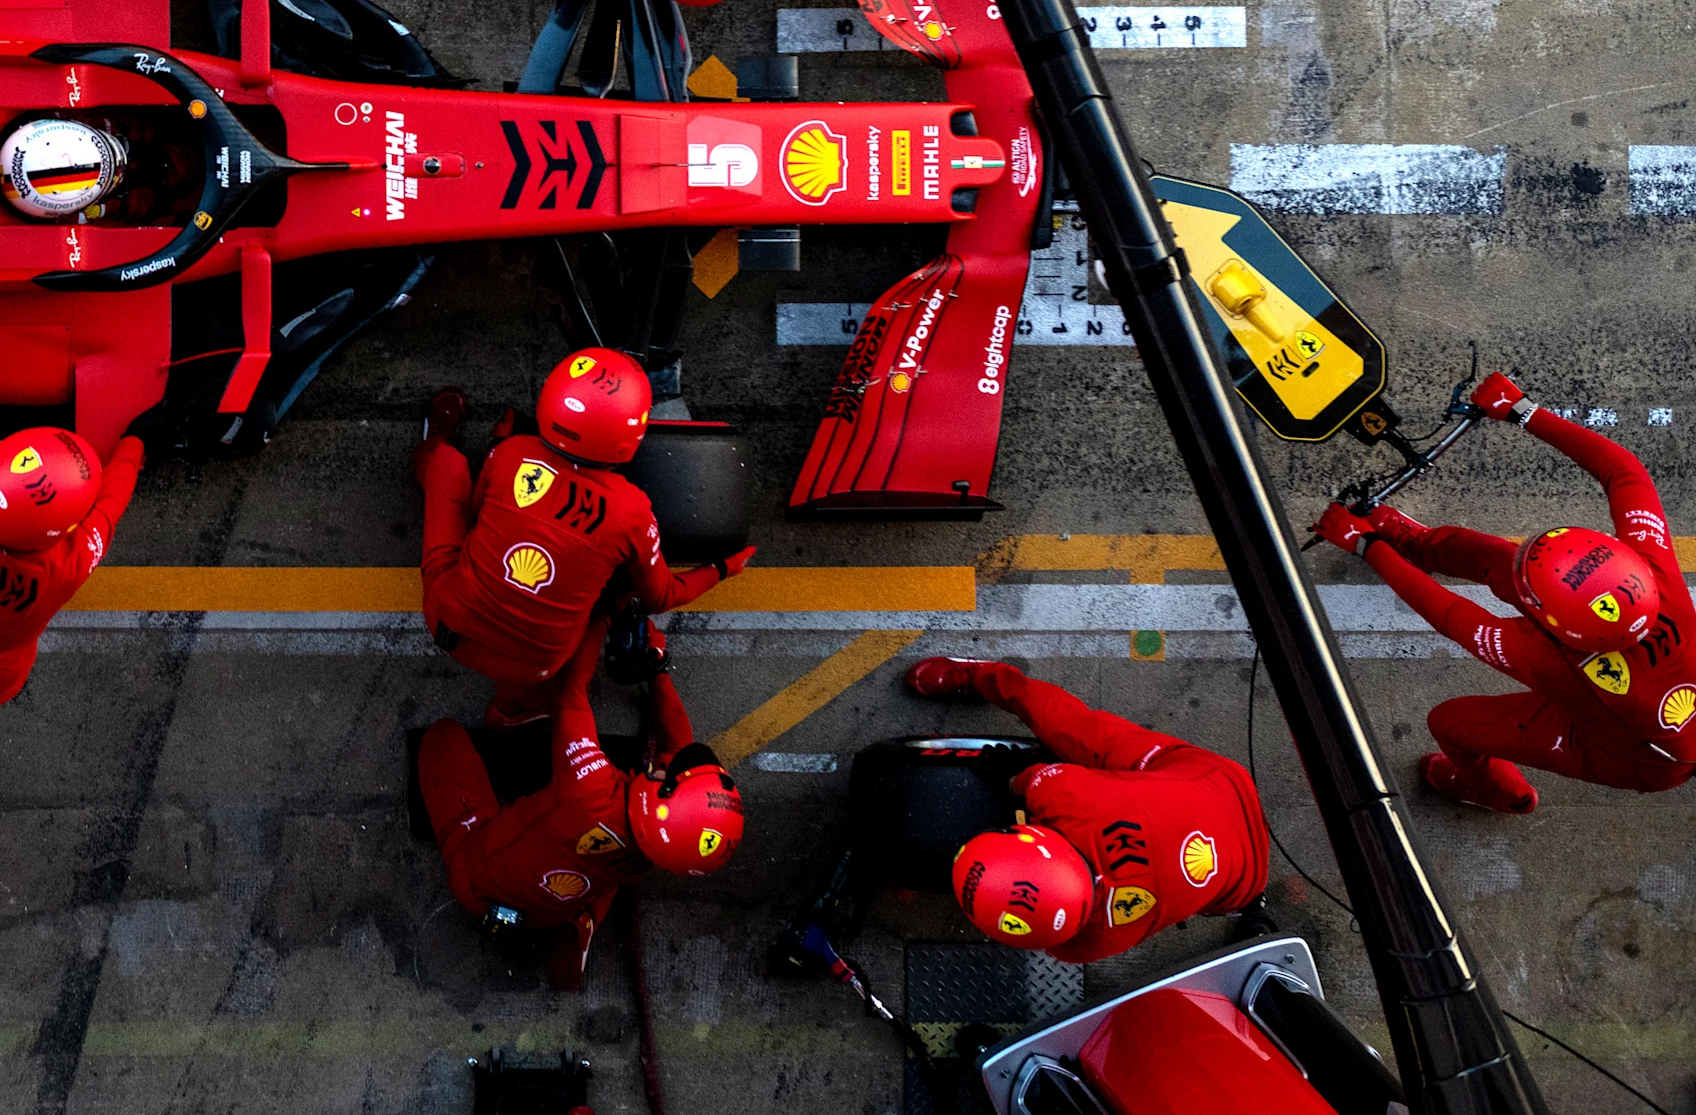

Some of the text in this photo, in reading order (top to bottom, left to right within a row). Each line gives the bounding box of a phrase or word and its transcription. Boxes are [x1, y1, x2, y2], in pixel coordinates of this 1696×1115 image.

[1116, 17, 1132, 31] 3
[1185, 15, 1201, 31] 5
[134, 52, 171, 75] Ray-Ban
[66, 68, 81, 107] Ray-Ban
[221, 147, 230, 187] WEICHAI
[386, 111, 405, 221] WEICHAI
[688, 144, 759, 187] 5
[866, 125, 881, 201] kaspersky
[923, 125, 939, 200] MAHLE
[32, 191, 94, 210] kaspersky
[66, 228, 81, 268] Ray-Ban
[120, 257, 176, 282] kaspersky
[841, 318, 858, 334] 5
[899, 289, 945, 369] V-Power
[984, 305, 1012, 378] eightcap
[1017, 320, 1103, 336] 0 1 2
[1628, 529, 1668, 550] Ray-Ban
[577, 759, 608, 781] HUBLOT
